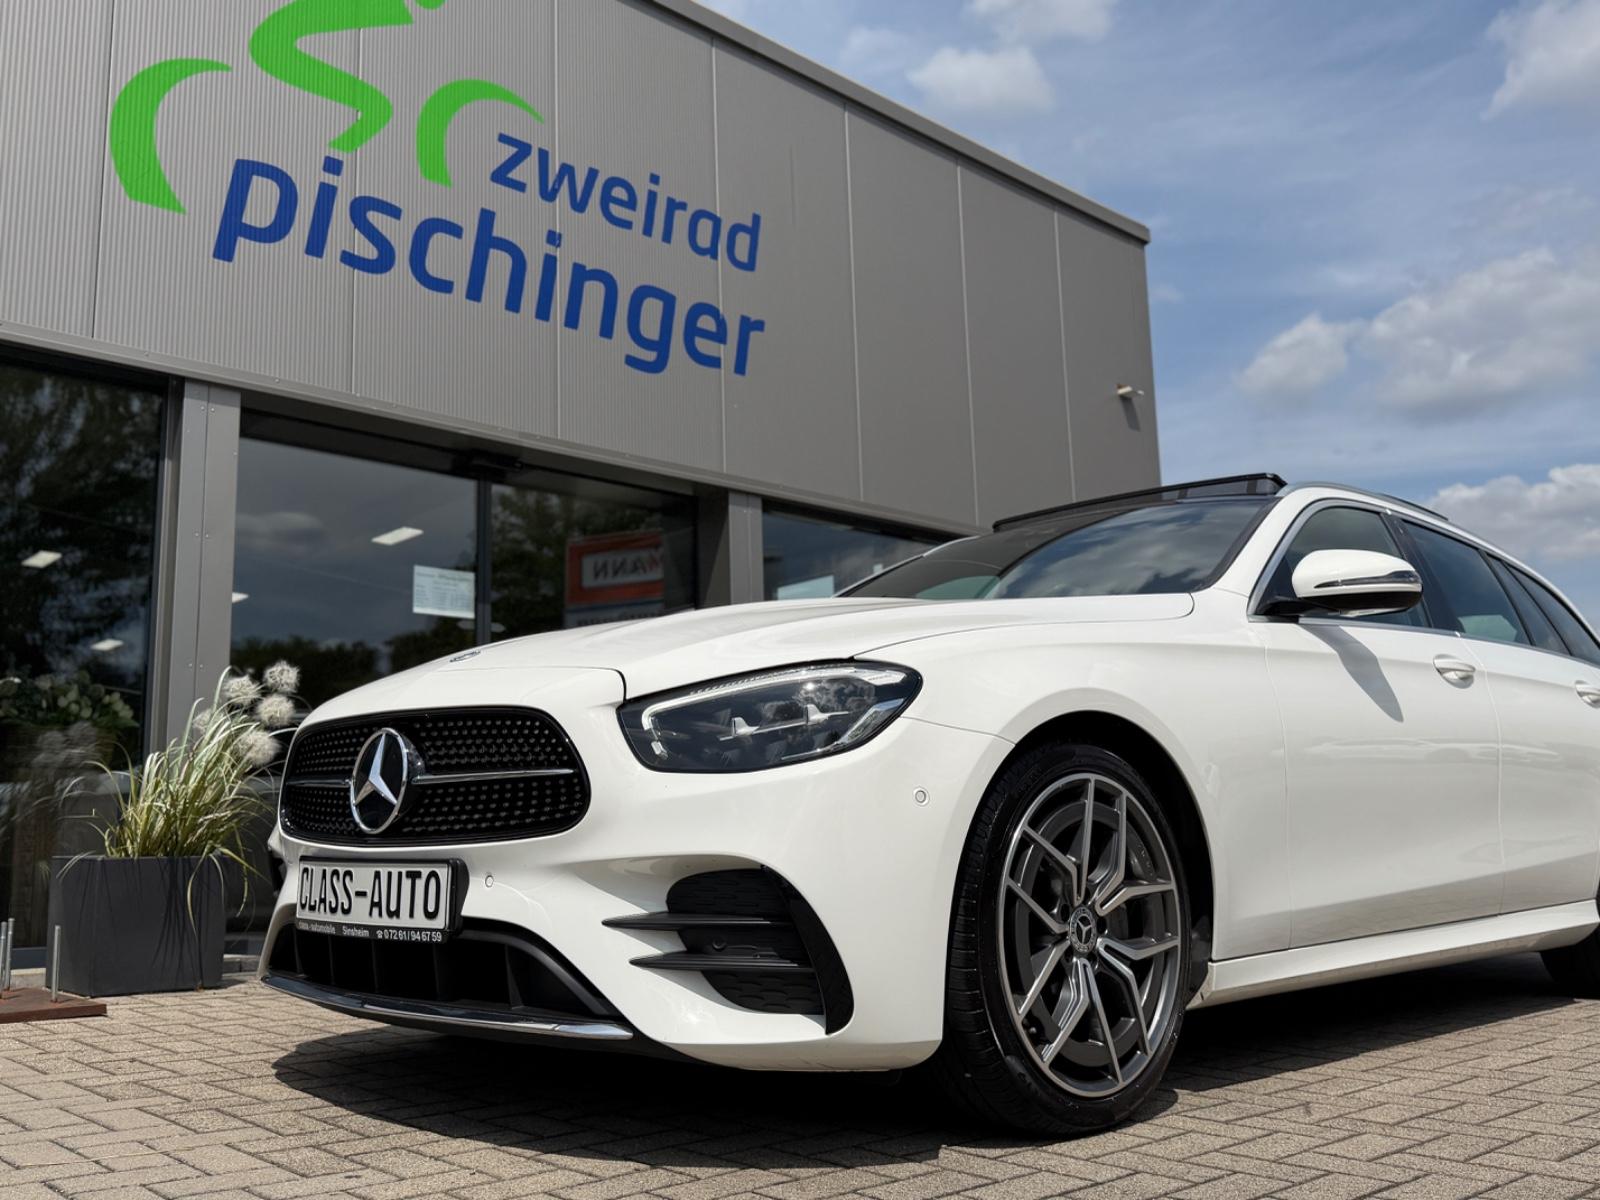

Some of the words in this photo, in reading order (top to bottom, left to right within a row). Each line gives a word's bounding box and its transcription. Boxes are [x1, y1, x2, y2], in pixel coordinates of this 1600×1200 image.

[213, 156, 765, 376] pischinger
[490, 133, 761, 272] zweirad
[300, 867, 441, 920] CLASS-AUTO
